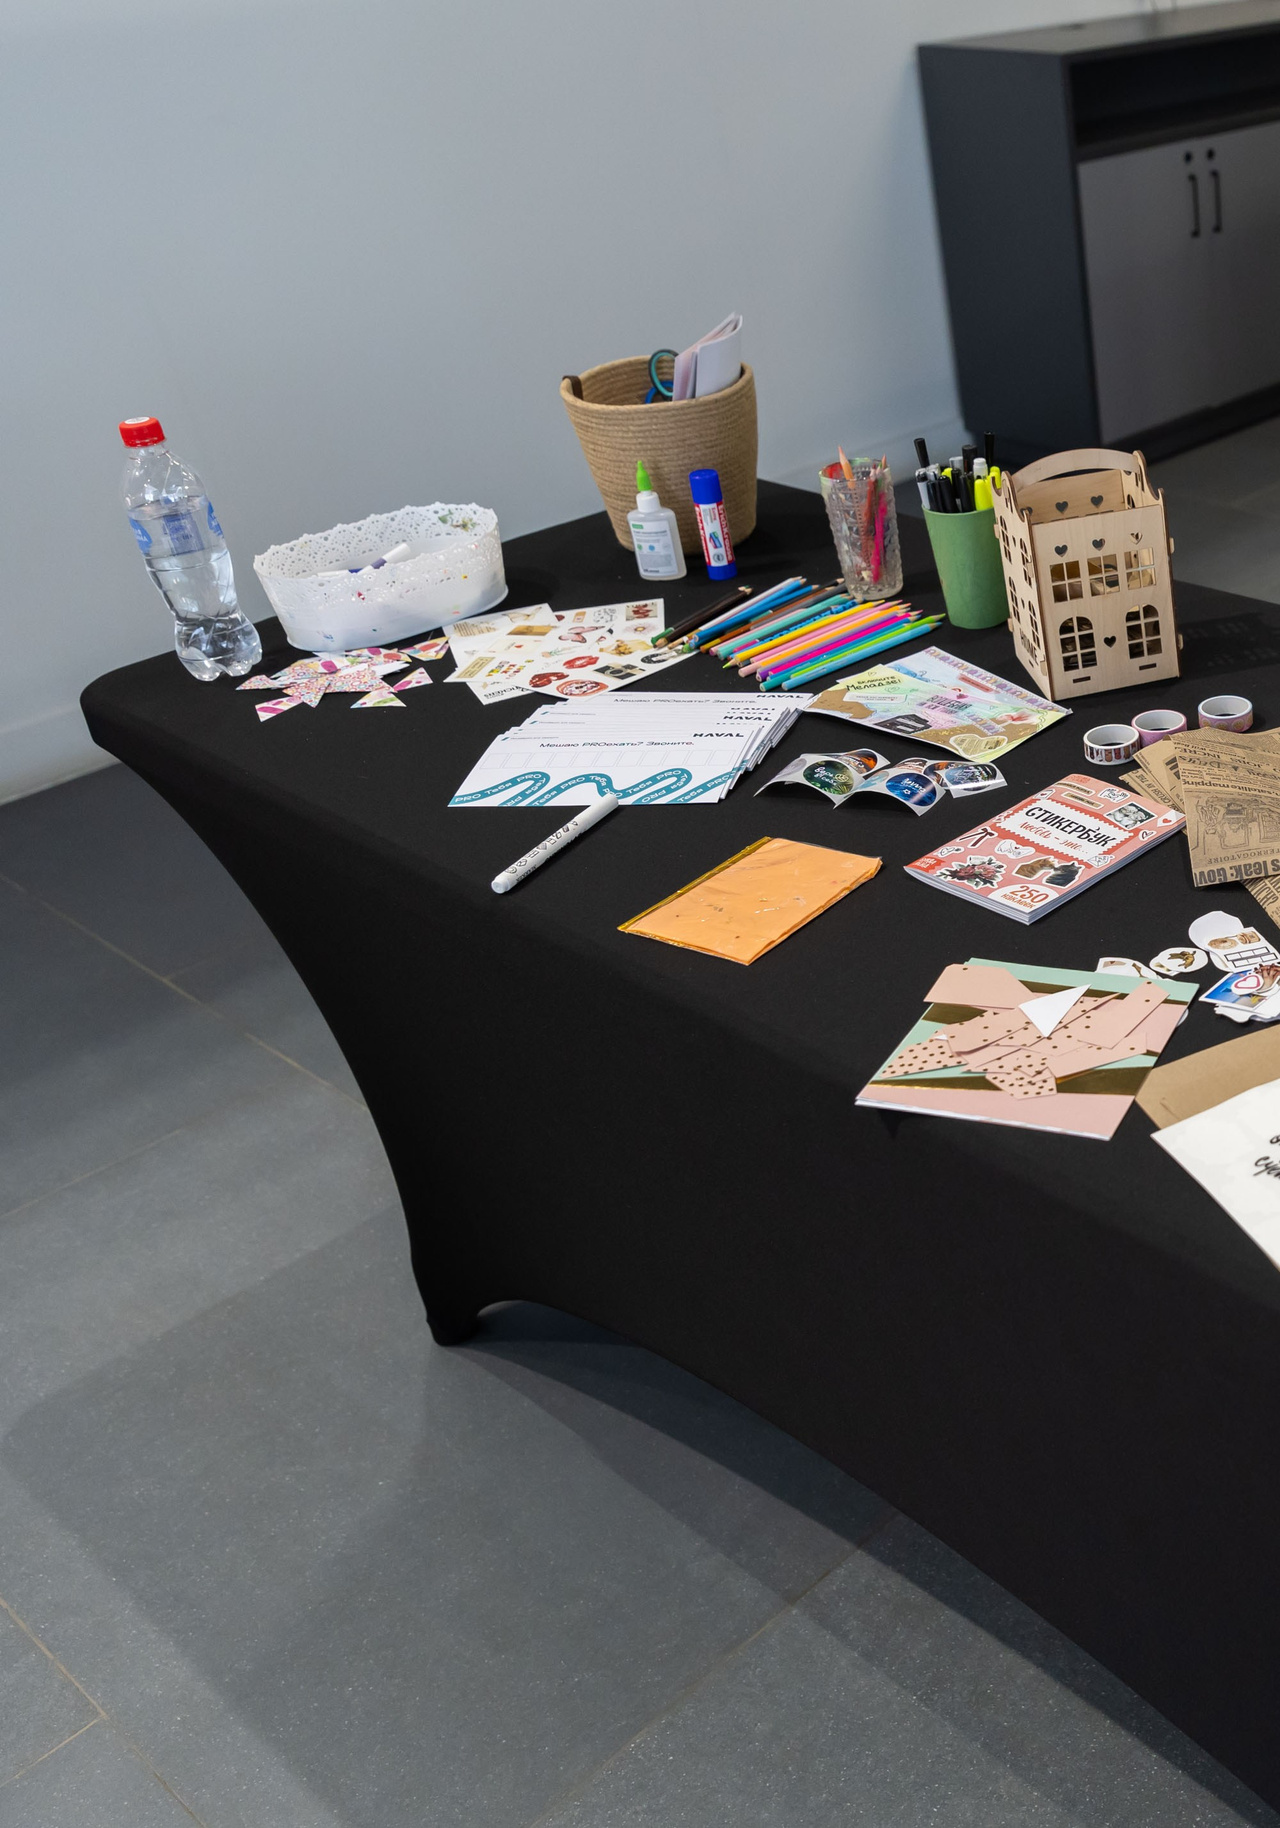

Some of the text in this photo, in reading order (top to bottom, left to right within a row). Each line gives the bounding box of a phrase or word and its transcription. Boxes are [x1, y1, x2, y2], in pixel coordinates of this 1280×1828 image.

[717, 504, 733, 562] ErichKrause
[1025, 806, 1118, 847] СТИКЕРБУК
[1229, 860, 1269, 882] leak:
[1010, 885, 1050, 904] 250
